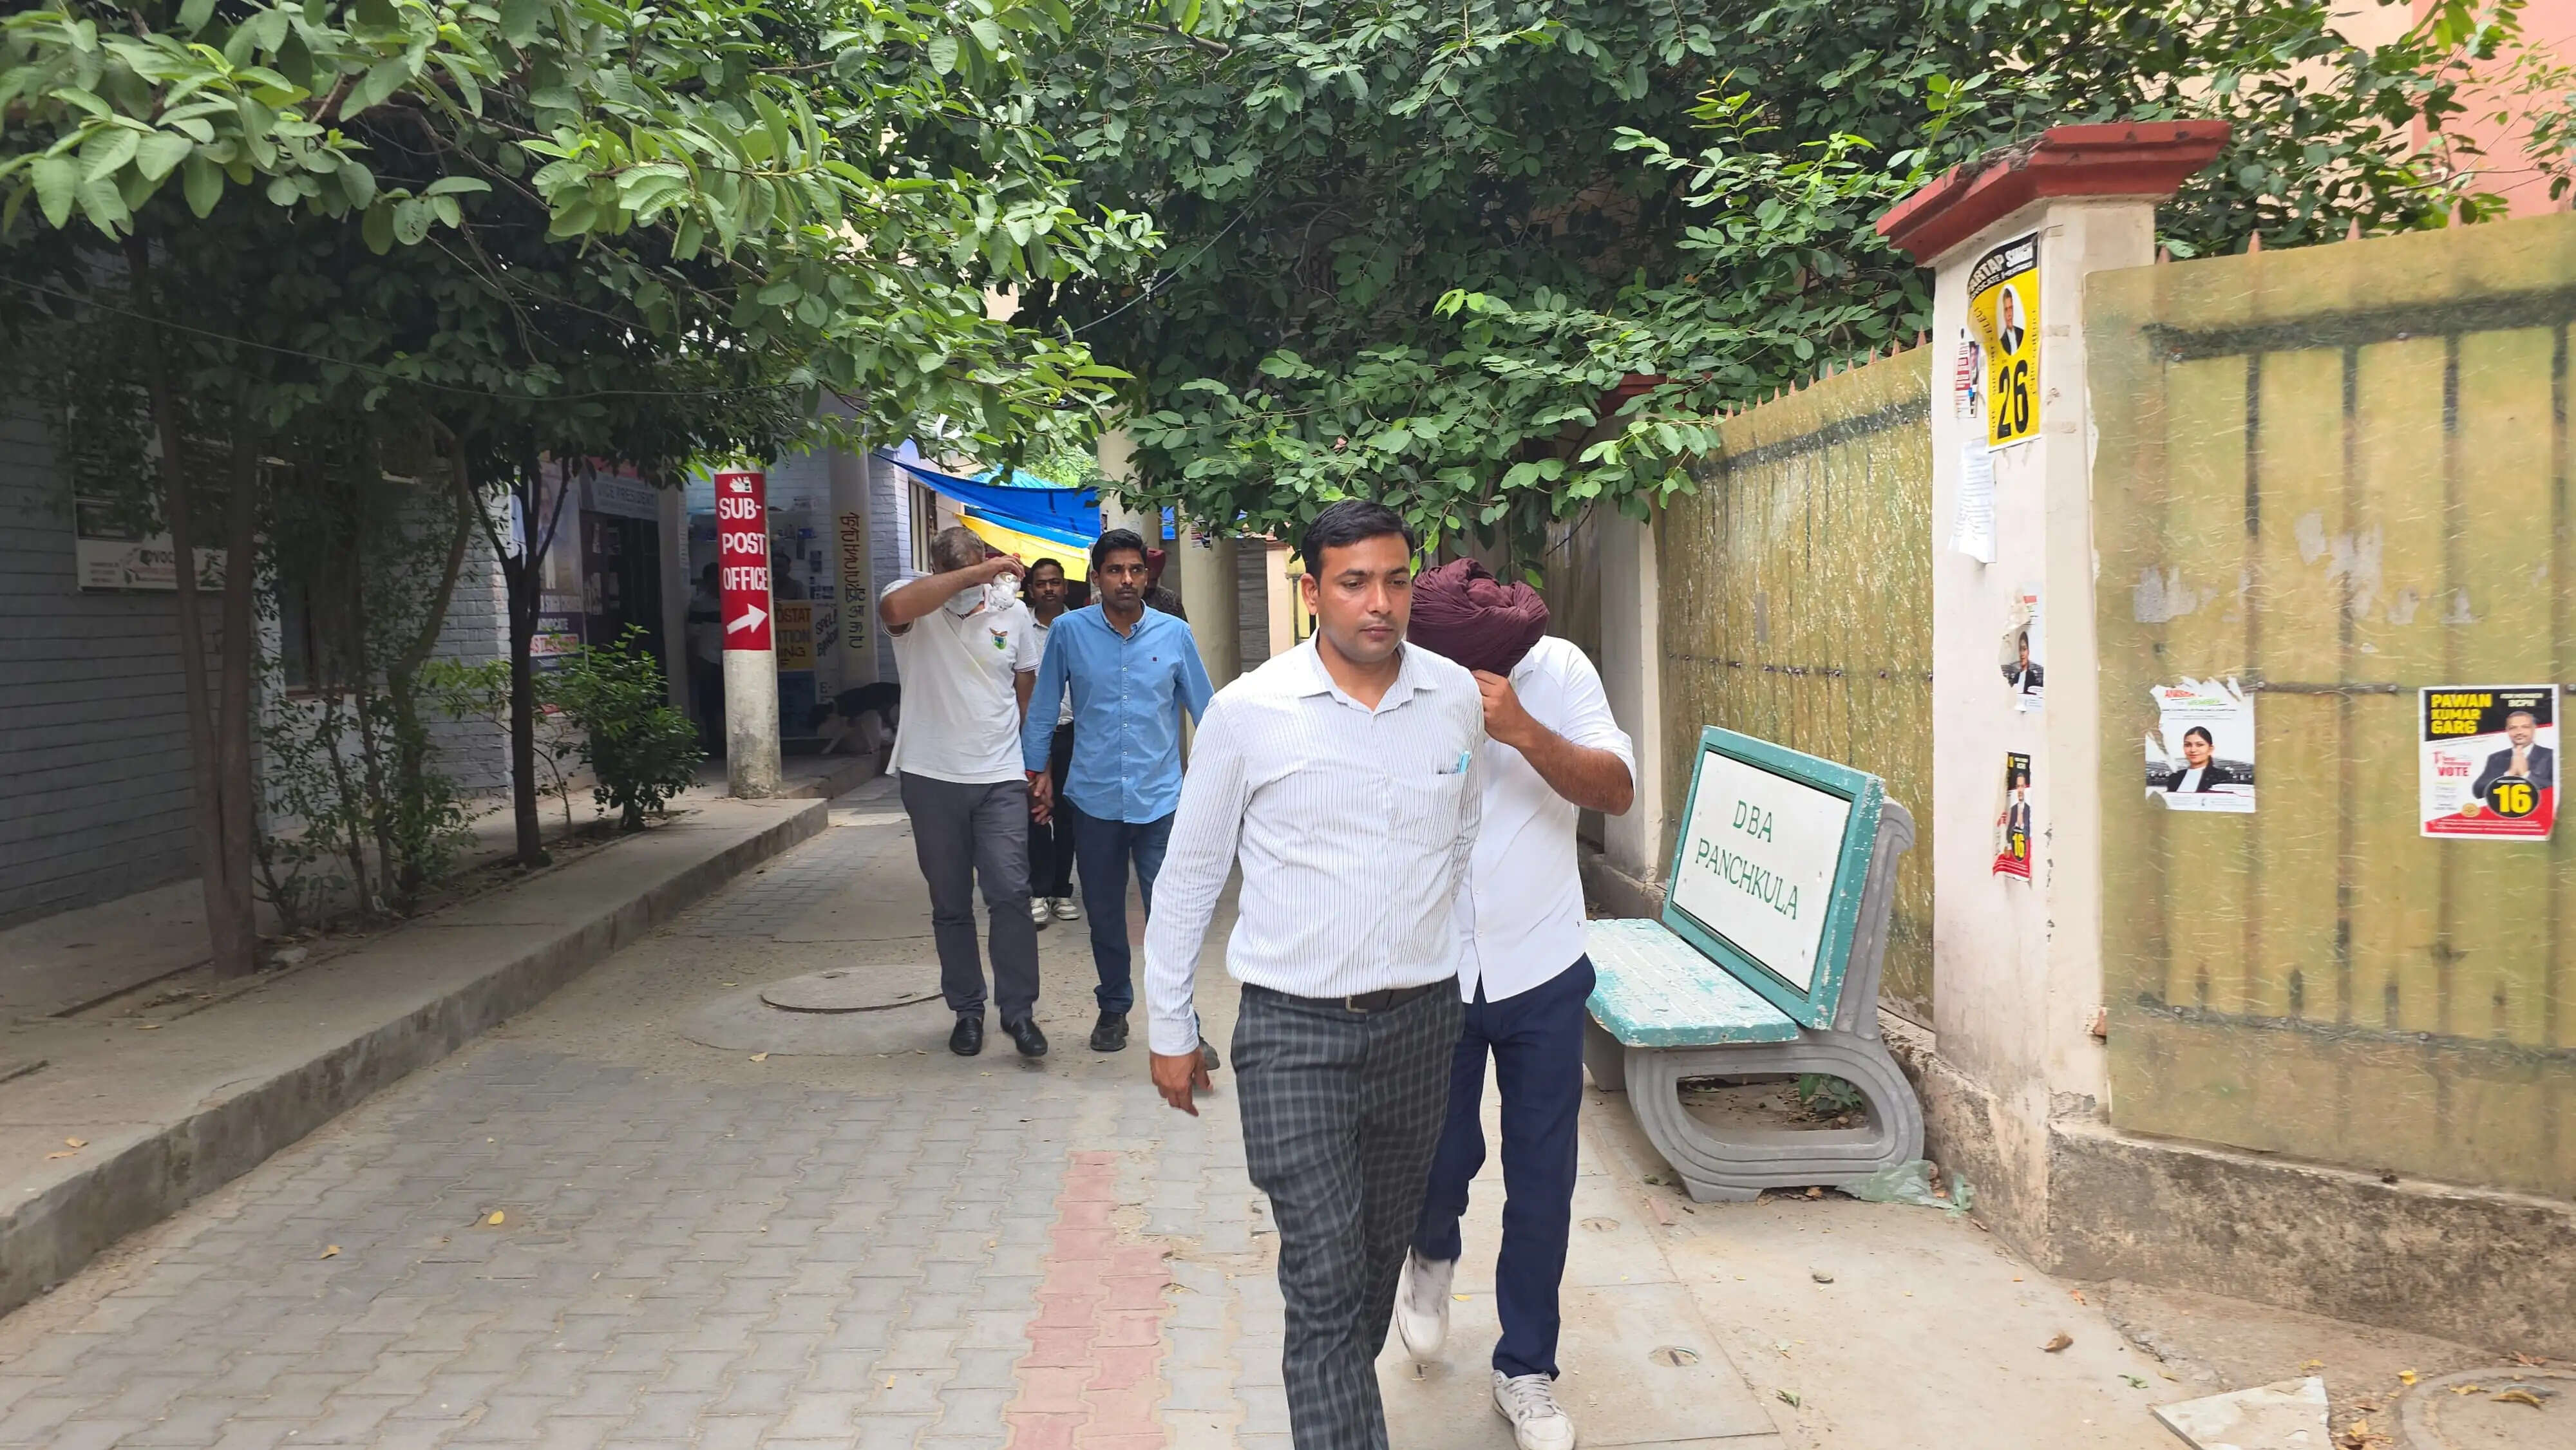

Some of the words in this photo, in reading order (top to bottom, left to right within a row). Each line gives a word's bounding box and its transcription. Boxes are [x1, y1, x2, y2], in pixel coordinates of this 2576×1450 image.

[1997, 359, 2030, 440] 26
[719, 497, 762, 520] SUB-
[723, 532, 766, 554] POST
[723, 567, 768, 590] OFFICE
[2430, 693, 2492, 708] PAWAN
[2430, 709, 2481, 720] KUMAR
[2430, 720, 2478, 735] GARG
[2438, 766, 2470, 777] VOTE
[2493, 784, 2532, 814] 16
[1732, 800, 1773, 843] DBA
[2012, 833, 2025, 858] 16
[1695, 838, 1799, 921] PANCHKULA
